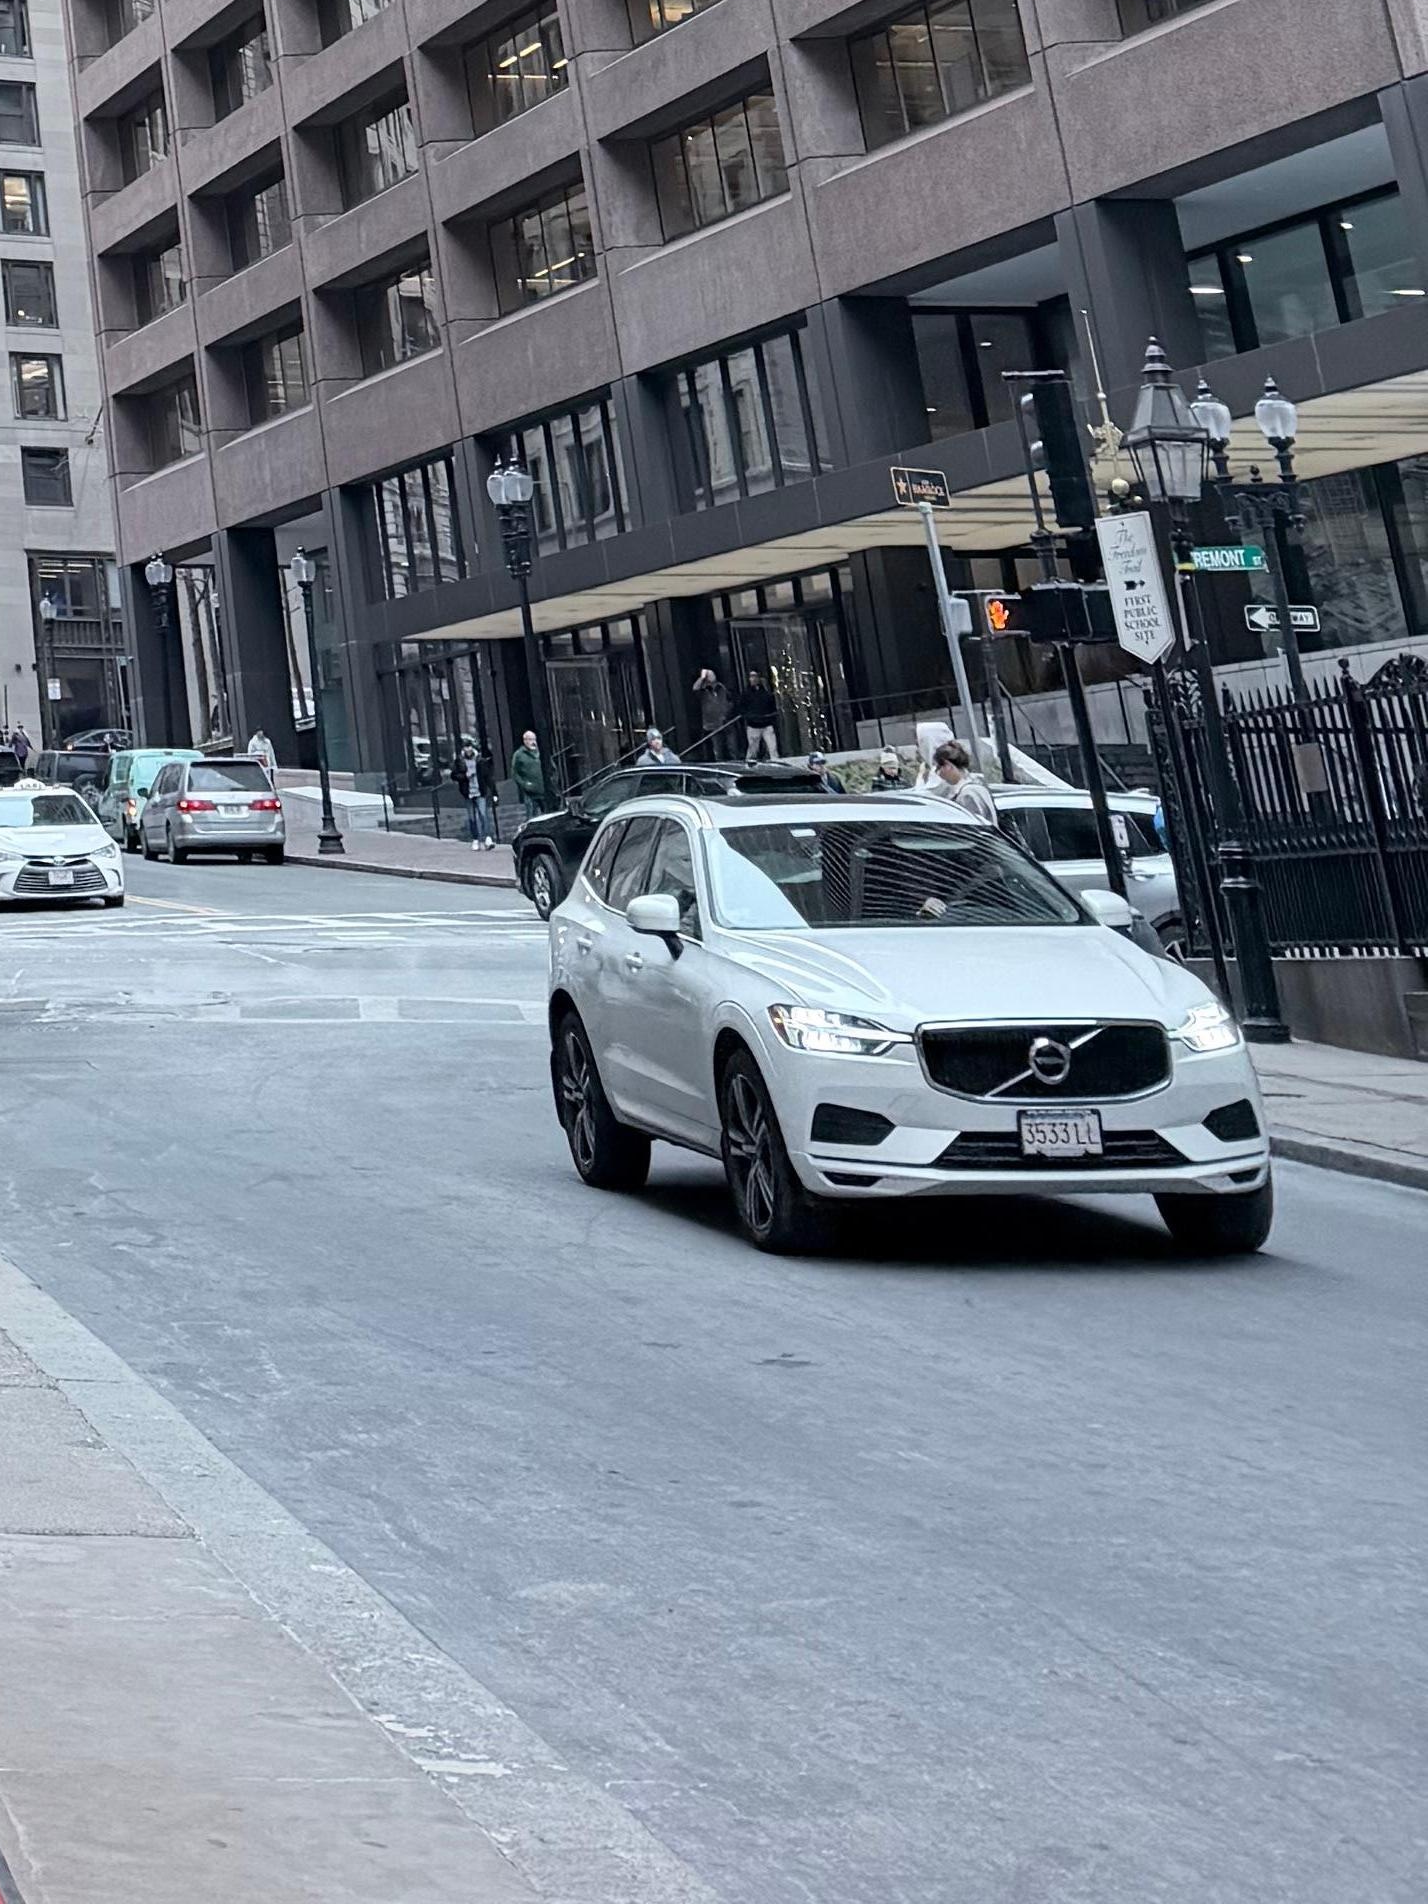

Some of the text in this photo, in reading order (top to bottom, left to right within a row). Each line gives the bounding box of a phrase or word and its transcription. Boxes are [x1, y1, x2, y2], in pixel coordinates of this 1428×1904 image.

[1124, 594, 1152, 607] FIRST
[1124, 605, 1158, 619] PUBLIC
[1125, 617, 1161, 632] SCHOOL
[1134, 630, 1155, 641] SITE
